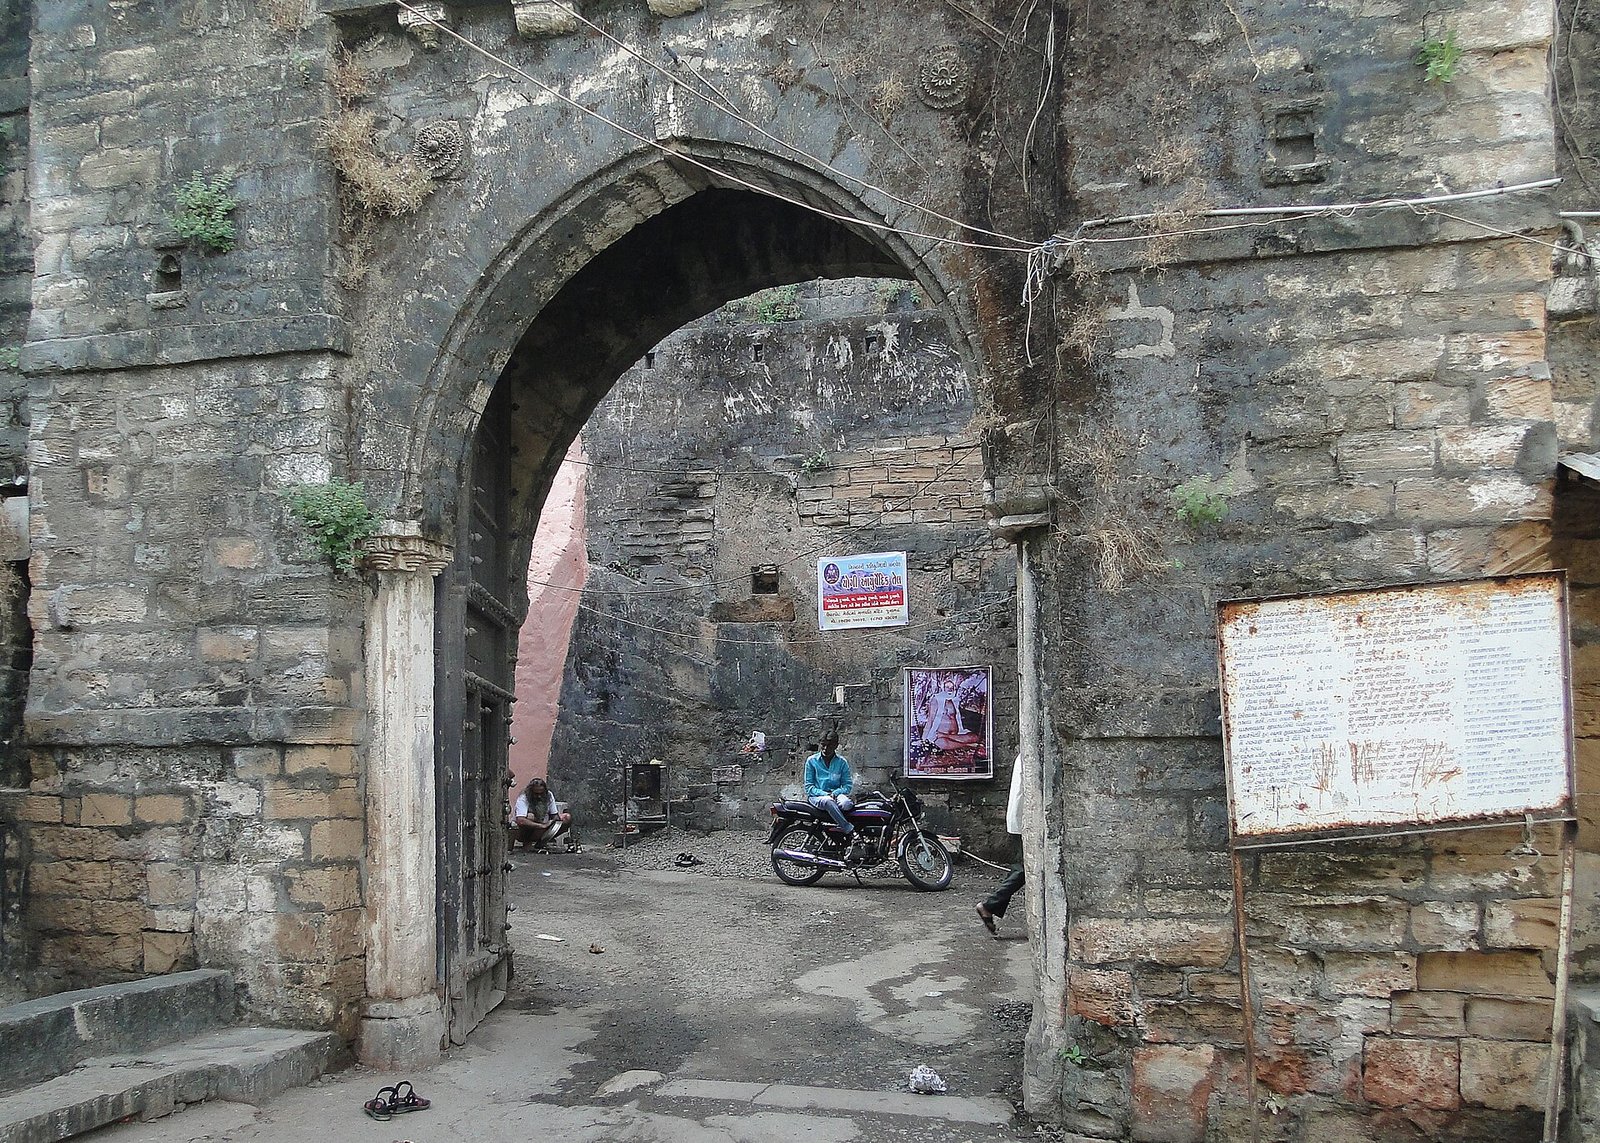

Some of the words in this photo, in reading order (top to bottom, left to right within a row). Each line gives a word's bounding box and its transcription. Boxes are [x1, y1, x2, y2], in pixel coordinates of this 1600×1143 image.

[842, 574, 858, 588] યોગી
[860, 572, 889, 590] આયુર્વેદિક
[891, 571, 902, 585] તેલ
